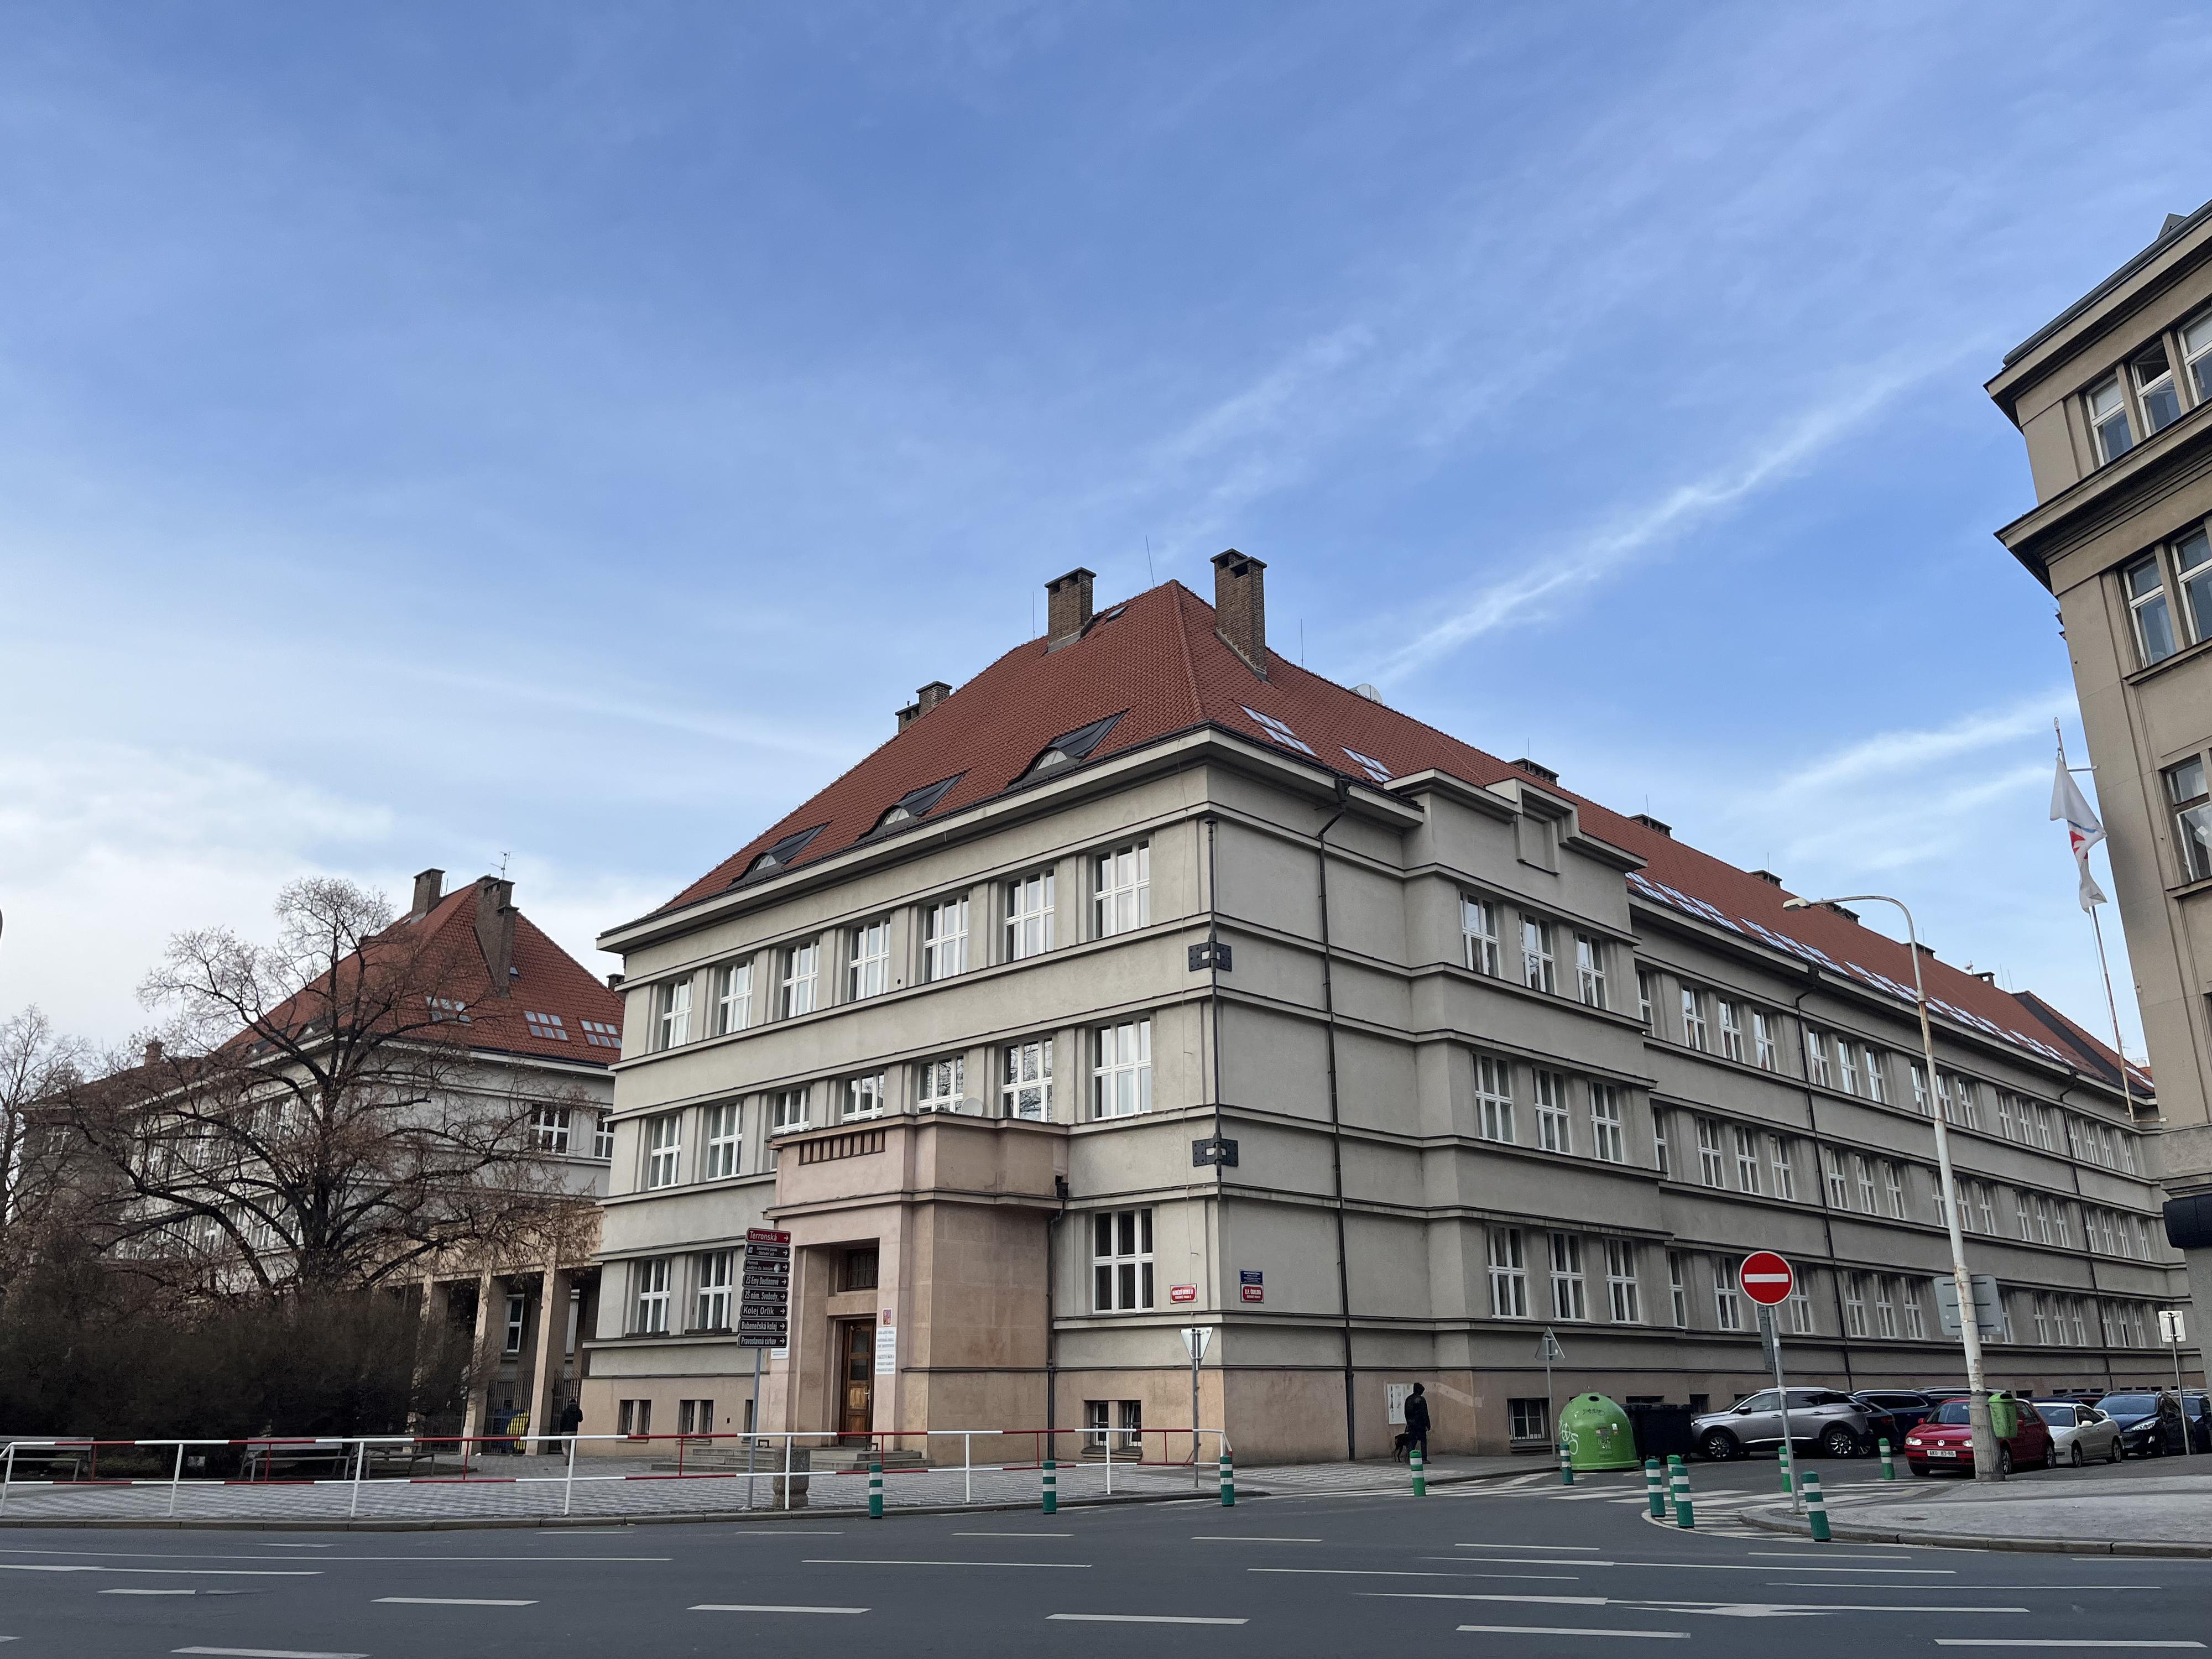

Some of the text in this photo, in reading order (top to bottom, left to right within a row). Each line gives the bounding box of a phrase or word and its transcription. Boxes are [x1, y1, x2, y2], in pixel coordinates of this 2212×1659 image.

[750, 1231, 777, 1241] Terronská
[746, 1275, 750, 1284] ZŠ
[745, 1290, 750, 1299] ZŠ
[761, 1292, 778, 1302] Svobody
[743, 1306, 774, 1316] Kolej Orlík
[742, 1321, 777, 1331] Bubenečská kolej
[742, 1337, 776, 1345] Pravoslavná církev
